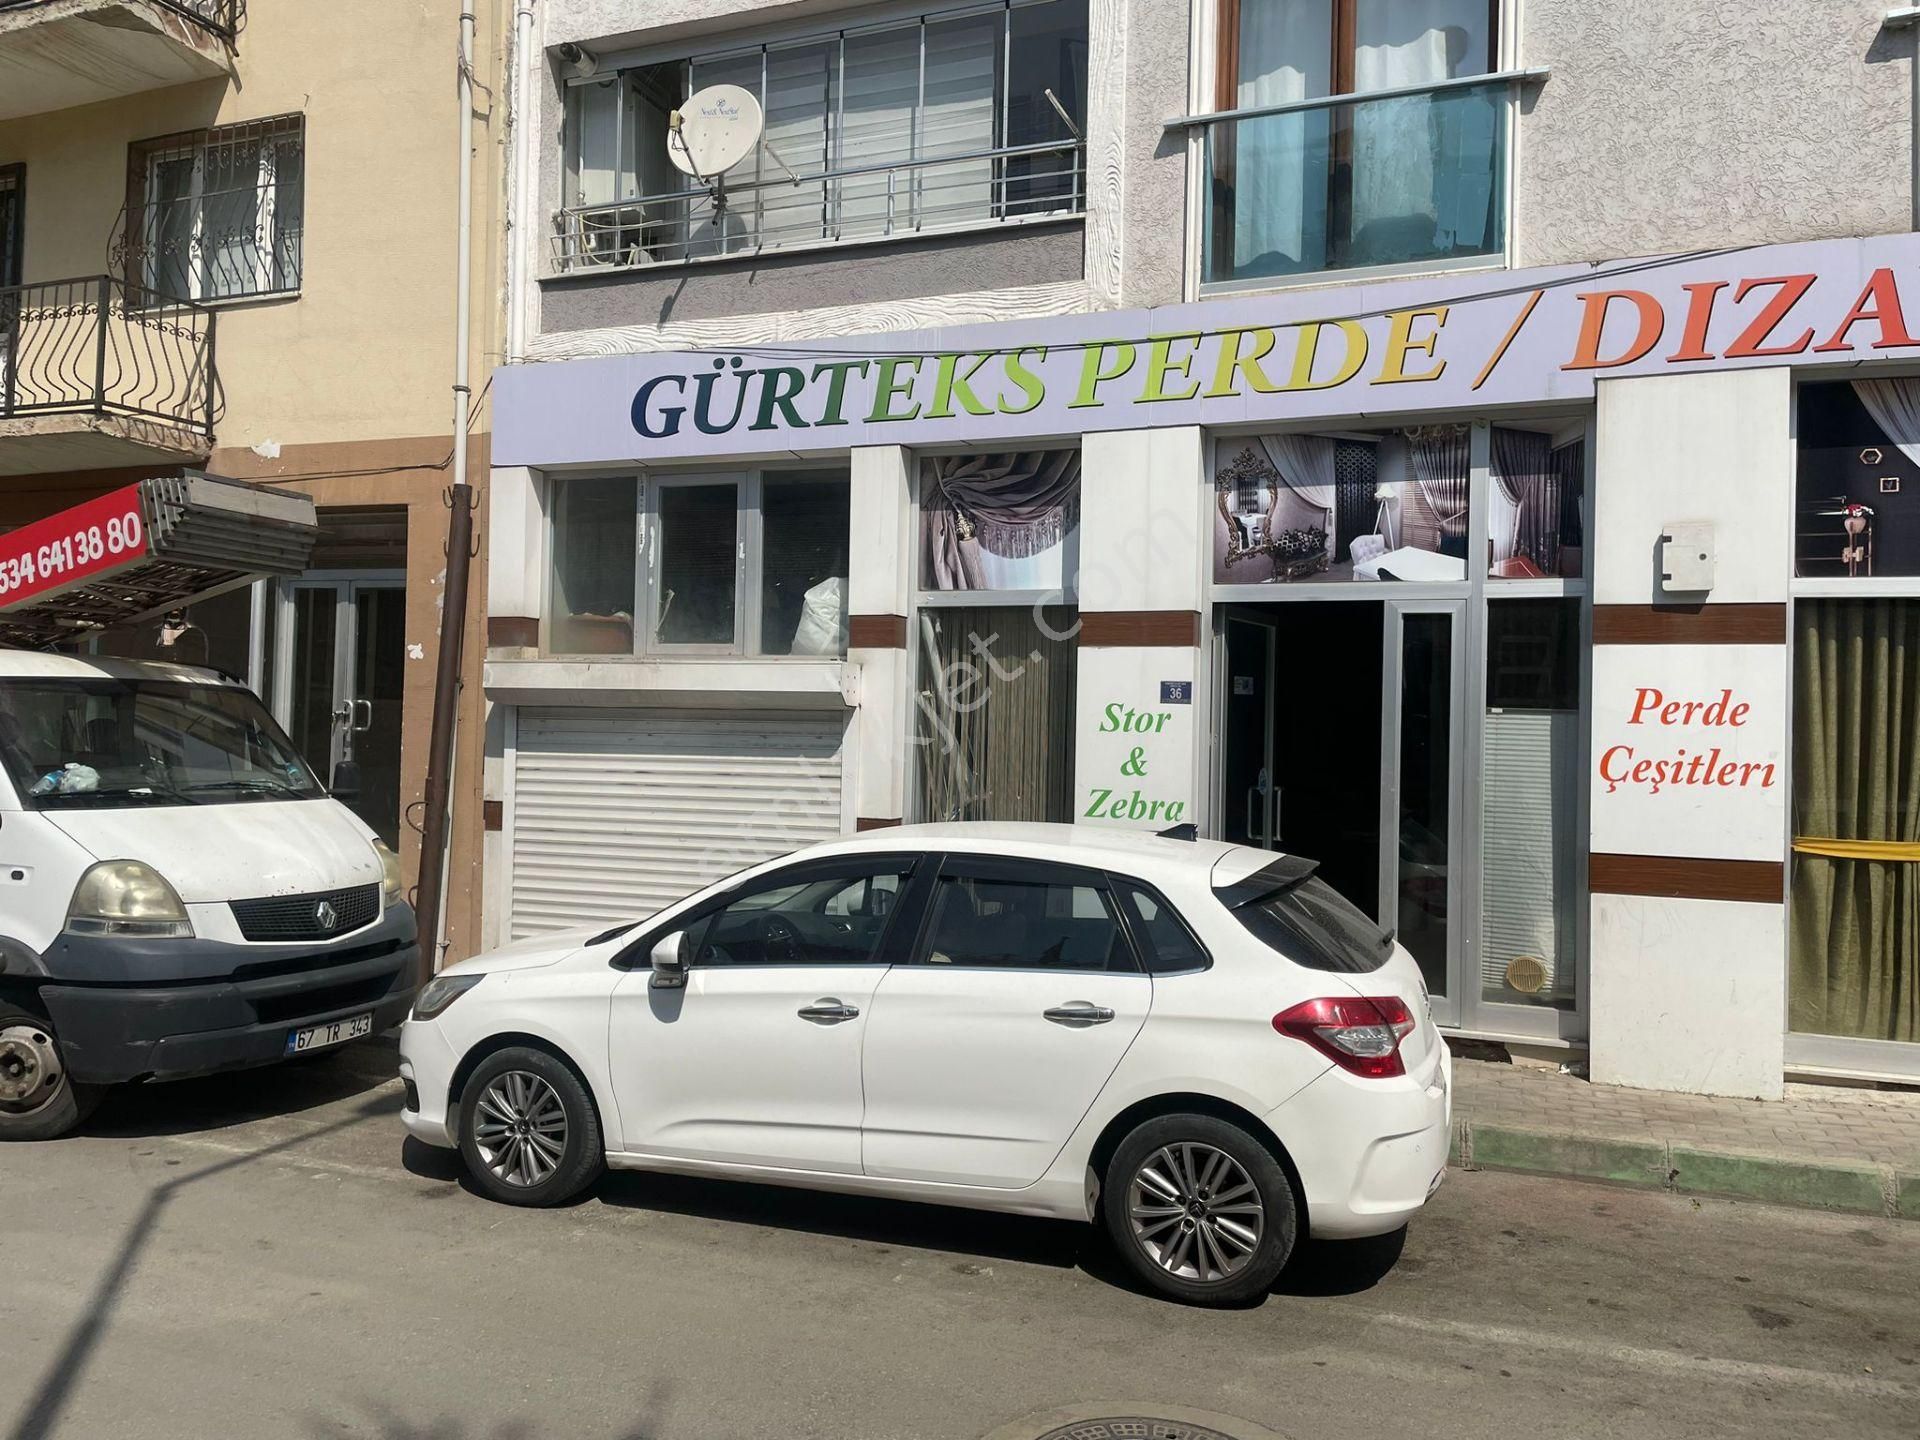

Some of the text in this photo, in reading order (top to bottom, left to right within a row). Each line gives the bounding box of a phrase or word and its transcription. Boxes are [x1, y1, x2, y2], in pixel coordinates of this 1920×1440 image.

[630, 345, 1049, 438] GÜRTEKS
[1067, 307, 1449, 409] PERDE
[107, 512, 141, 553] 80
[1169, 687, 1182, 699] 36
[1626, 688, 1751, 727] Perde
[1099, 703, 1172, 733] Stor
[1120, 746, 1148, 777] &
[1083, 789, 1185, 822] Zebra
[297, 1015, 370, 1049] 67 TR 343
